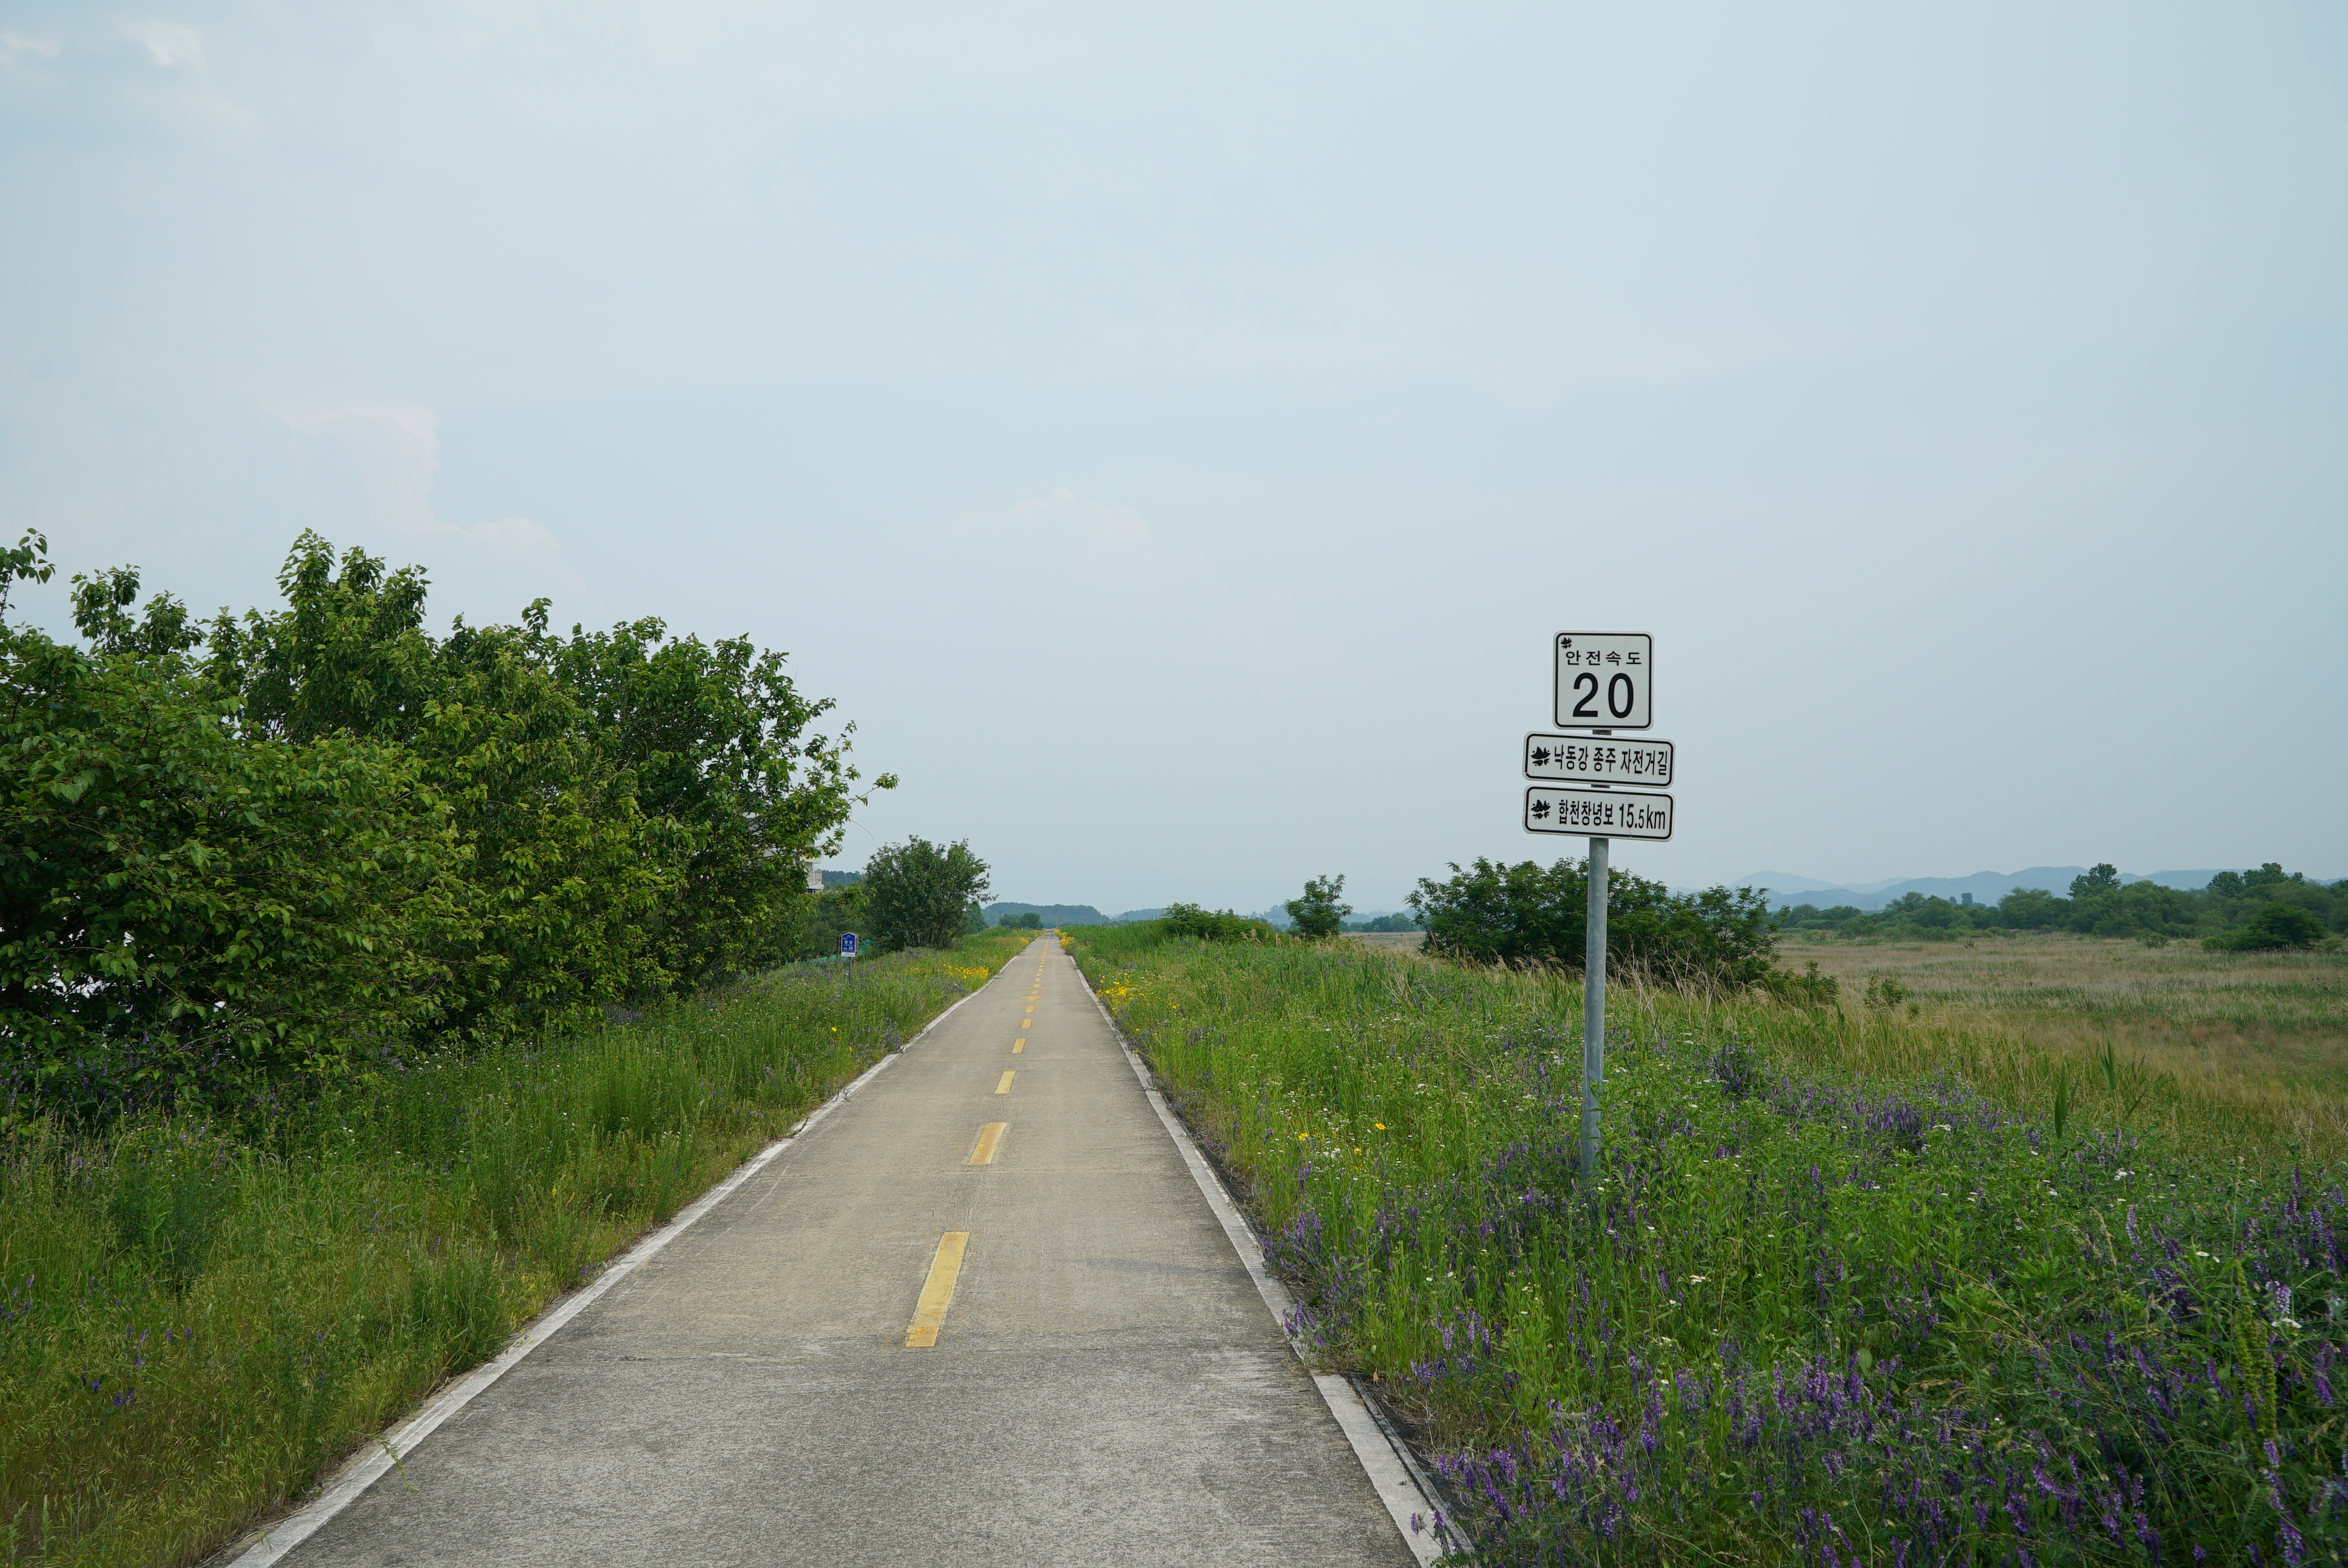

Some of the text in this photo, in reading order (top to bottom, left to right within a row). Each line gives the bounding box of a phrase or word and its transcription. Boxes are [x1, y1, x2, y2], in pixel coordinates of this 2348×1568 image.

[1566, 650, 1641, 666] 안전속도
[1573, 672, 1634, 719] 20
[1554, 744, 1668, 776] 낙동강 종주 자전거길
[1559, 800, 1666, 830] 합천창녕보 15.5km
